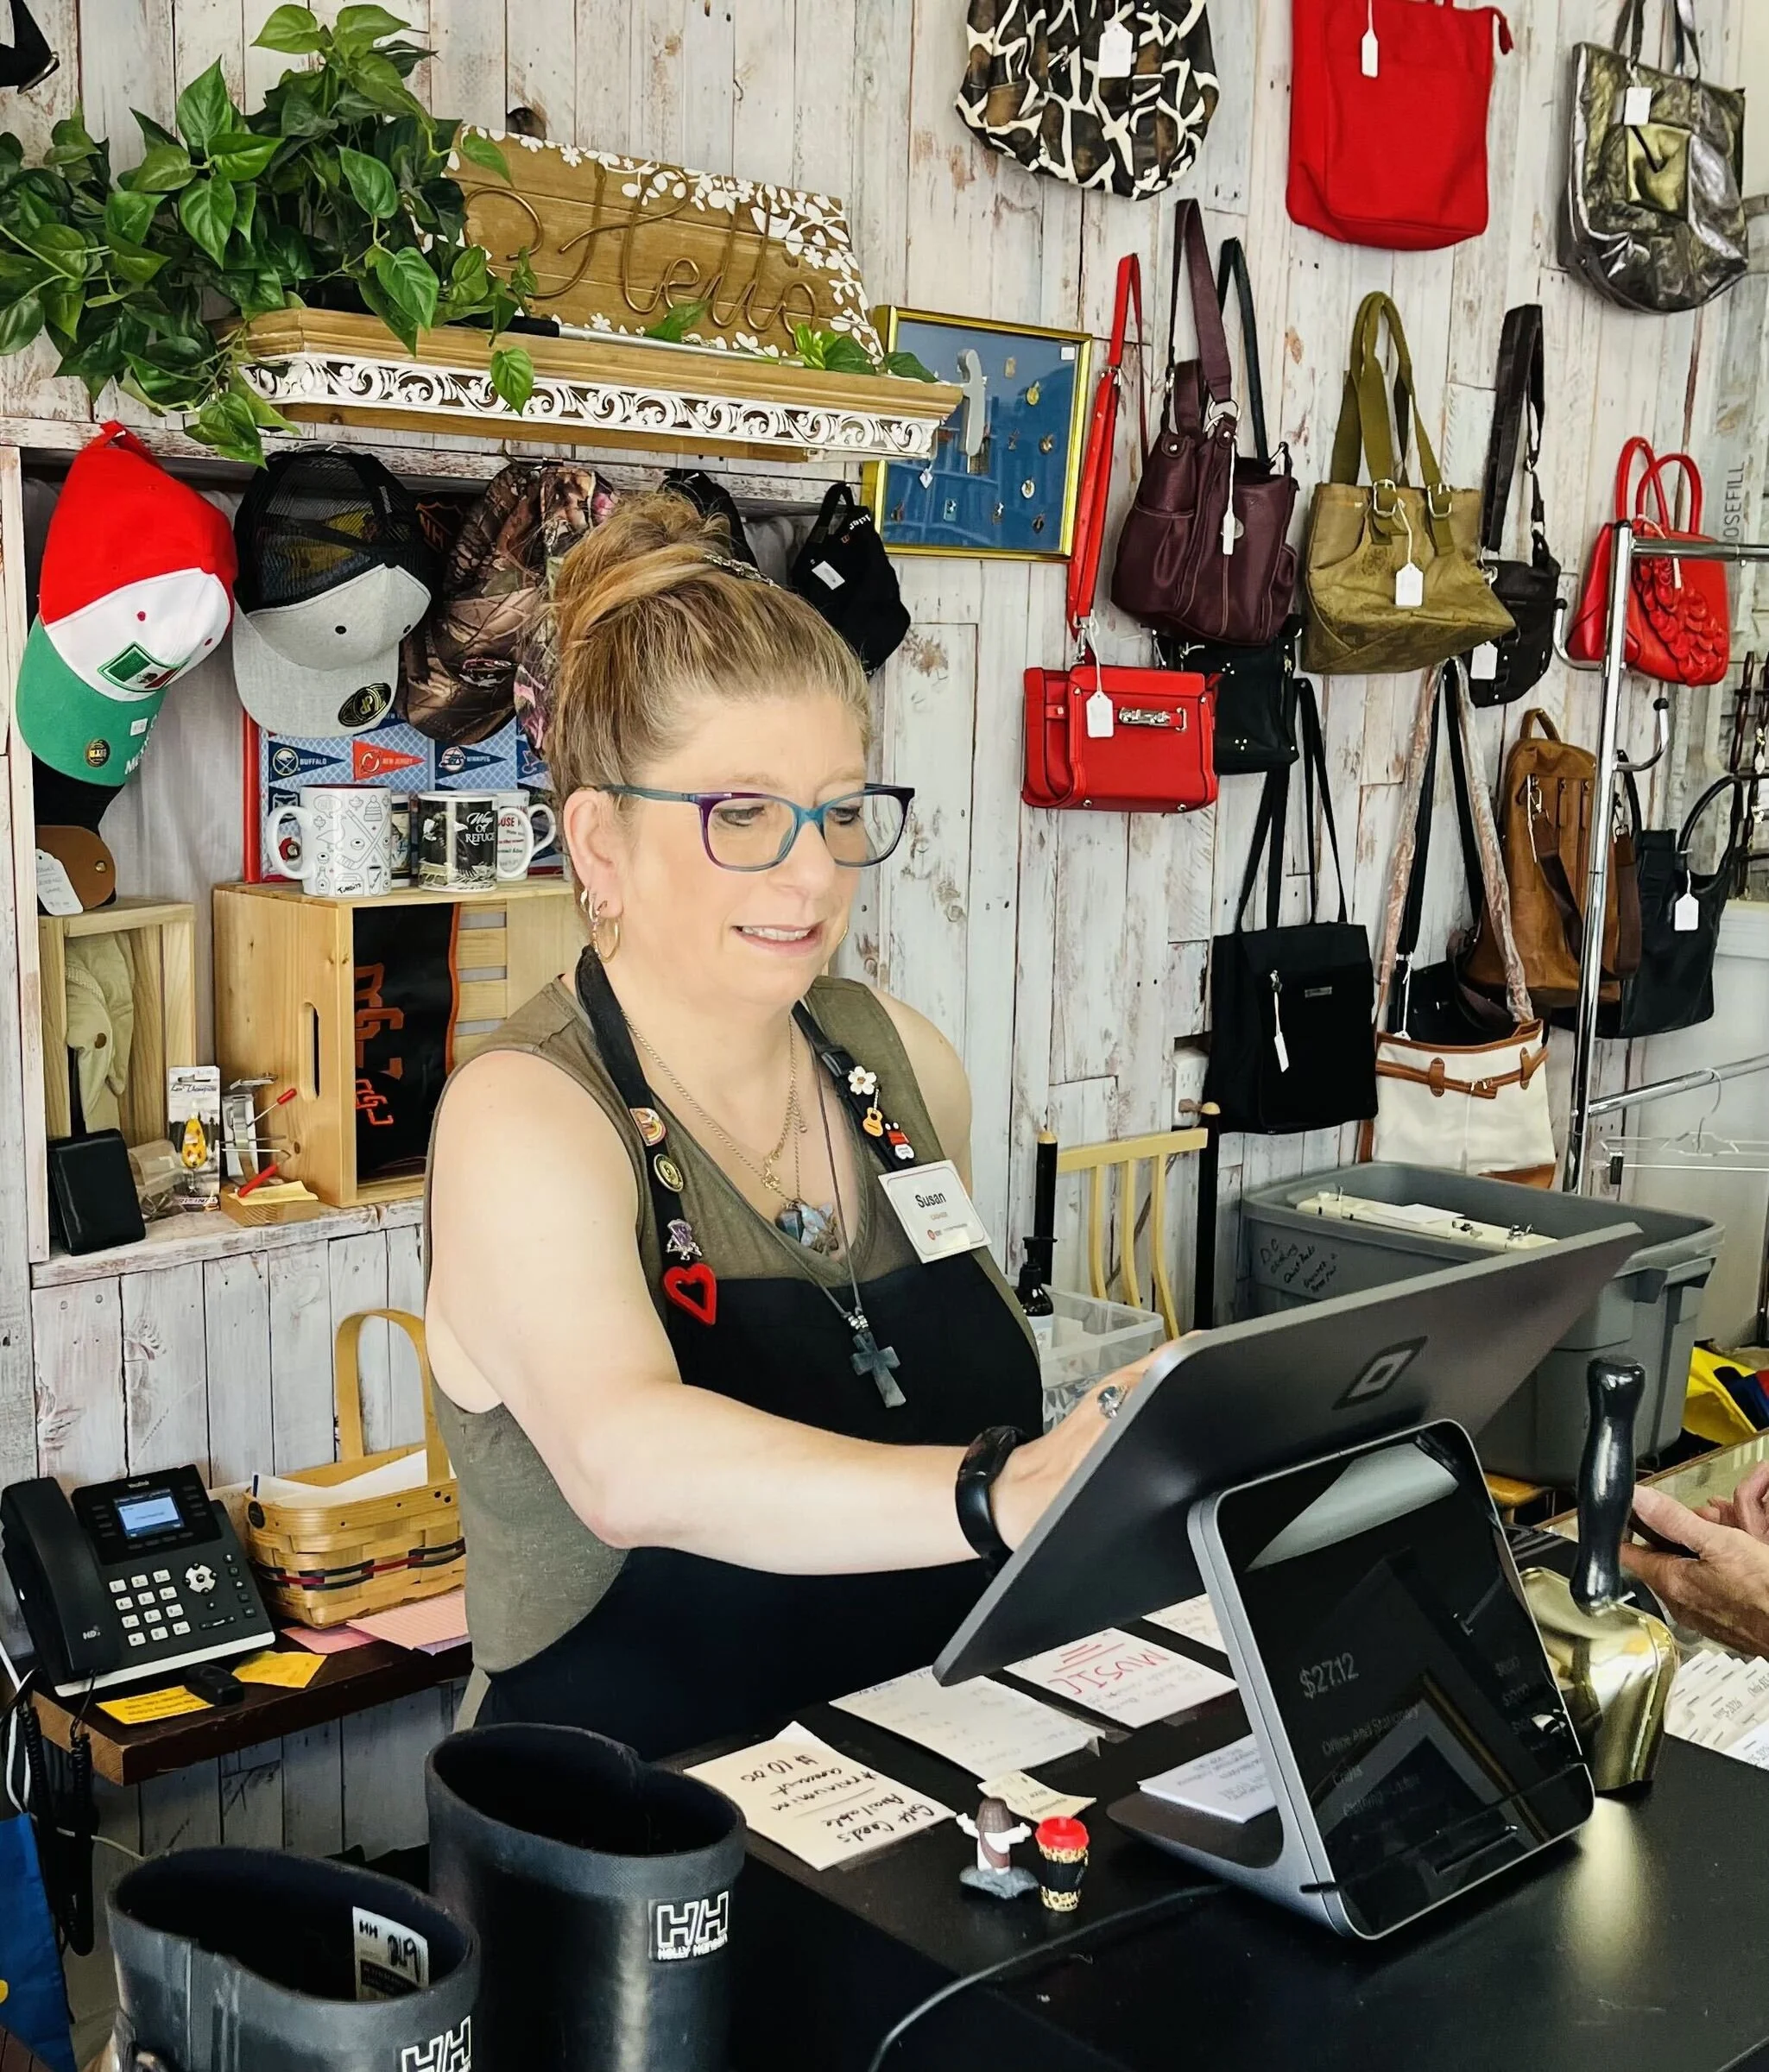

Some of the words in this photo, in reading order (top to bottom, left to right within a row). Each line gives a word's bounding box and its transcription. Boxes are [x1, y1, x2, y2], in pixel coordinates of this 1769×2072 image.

[464, 164, 818, 333] Hello
[498, 816, 515, 827] USE
[464, 831, 495, 845] REFUGE
[915, 1192, 946, 1209] Susan
[1047, 1648, 1170, 1696] MUSIC
[1299, 1652, 1361, 1699] $27.12
[823, 1793, 906, 1828] Available
[899, 1803, 935, 1824] Gift
[359, 1919, 378, 1939] HH
